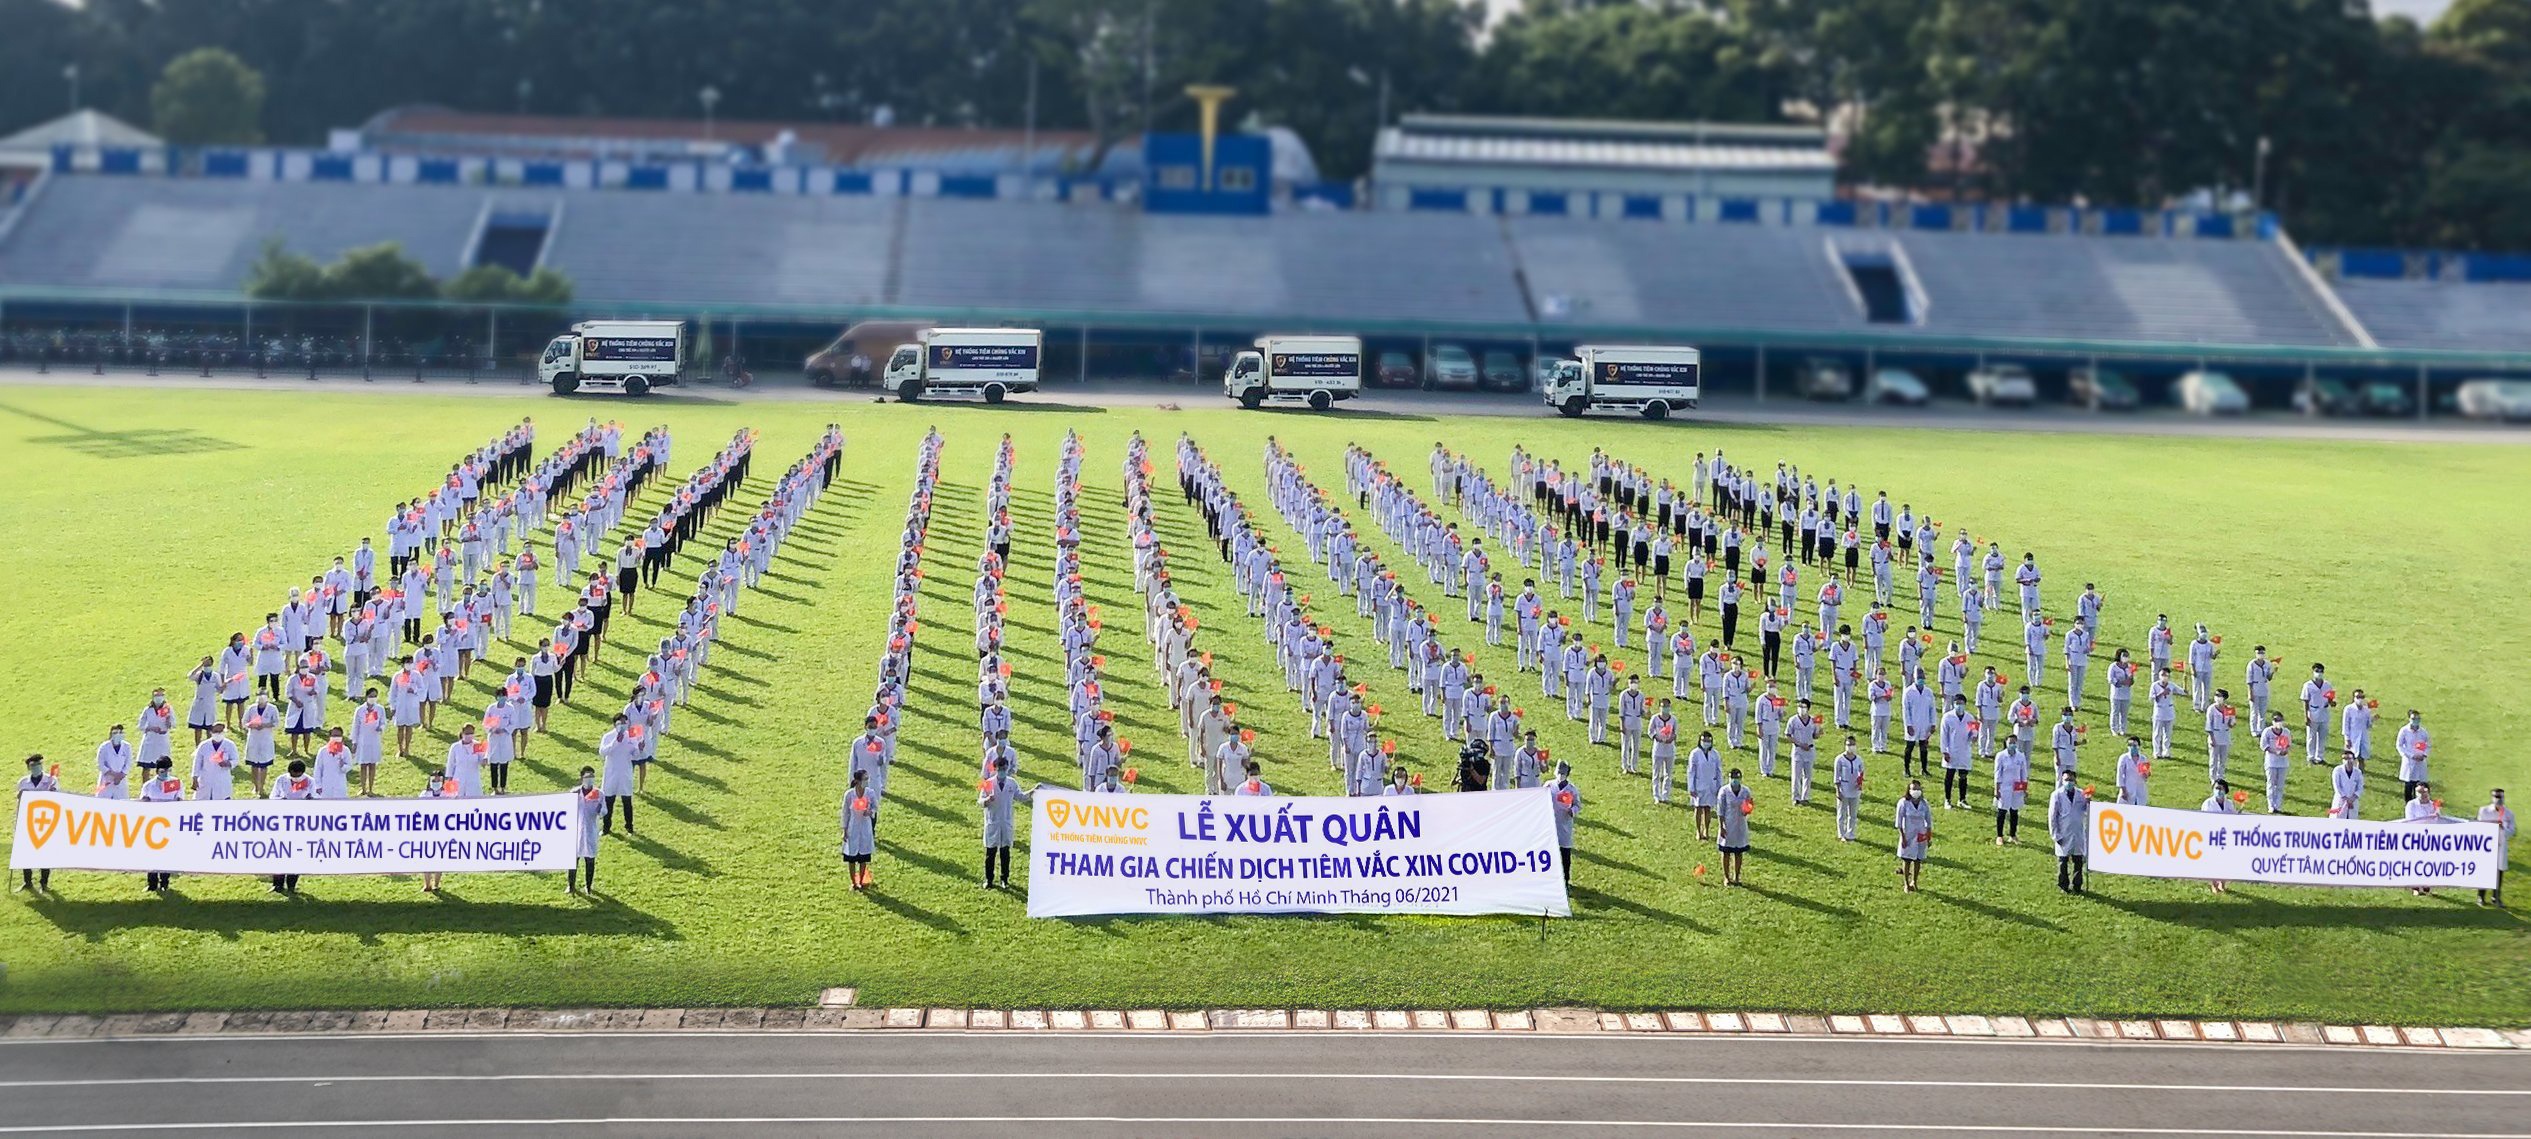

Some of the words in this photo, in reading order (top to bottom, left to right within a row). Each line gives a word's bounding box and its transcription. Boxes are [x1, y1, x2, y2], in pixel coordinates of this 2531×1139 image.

[66, 809, 171, 850] VNVC
[179, 812, 204, 836] HỆ
[211, 810, 280, 832] THỐNG
[283, 814, 348, 832] TRUNG
[350, 811, 391, 832] TÂM
[395, 811, 440, 832] TIÊM
[444, 808, 512, 831] CHỦNG
[515, 810, 567, 831] VNVC
[1074, 804, 1149, 831] VNVC
[1177, 799, 1217, 842] LỄ
[1223, 802, 1314, 844] XUẤT
[1321, 805, 1421, 847] QUÂN
[211, 841, 239, 860] AN
[242, 837, 291, 860] TOÀN
[306, 838, 341, 864] TẬN
[344, 838, 383, 859] TÂM
[398, 838, 471, 860] CHUYÊN
[476, 839, 542, 865] NGHIỆP
[2126, 821, 2203, 861] VNVC
[2209, 827, 2228, 850] HỆ
[2232, 824, 2281, 848] THỐNG
[2283, 831, 2332, 850] TRUNG
[2333, 828, 2363, 850] TÂM
[2364, 829, 2399, 851] TIÊM
[2401, 828, 2452, 852] CHỦNG
[2453, 834, 2493, 853] VNVC
[1046, 852, 1114, 878] THAM
[1119, 855, 1160, 879] GIA
[1165, 851, 1234, 880] CHIẾN
[1239, 857, 1294, 883] DỊCH
[1297, 853, 1353, 879] TIÊM
[1355, 849, 1401, 878] VẮC
[1404, 854, 1443, 877] XIN
[1448, 849, 1552, 876] COVID-19
[2251, 853, 2296, 875] QUYẾT
[2296, 855, 2325, 875] TÂM
[2327, 853, 2376, 877] CHỐNG
[2379, 861, 2412, 881] DỊCH
[2414, 860, 2476, 878] COVID-19
[1145, 888, 1198, 906] Thành
[1202, 889, 1234, 909] phố
[1239, 888, 1262, 905] Hồ
[1265, 889, 1292, 905] Chí
[1297, 889, 1337, 905] Minh
[1339, 888, 1391, 908] Tháng
[1395, 886, 1458, 905] 06/2021
